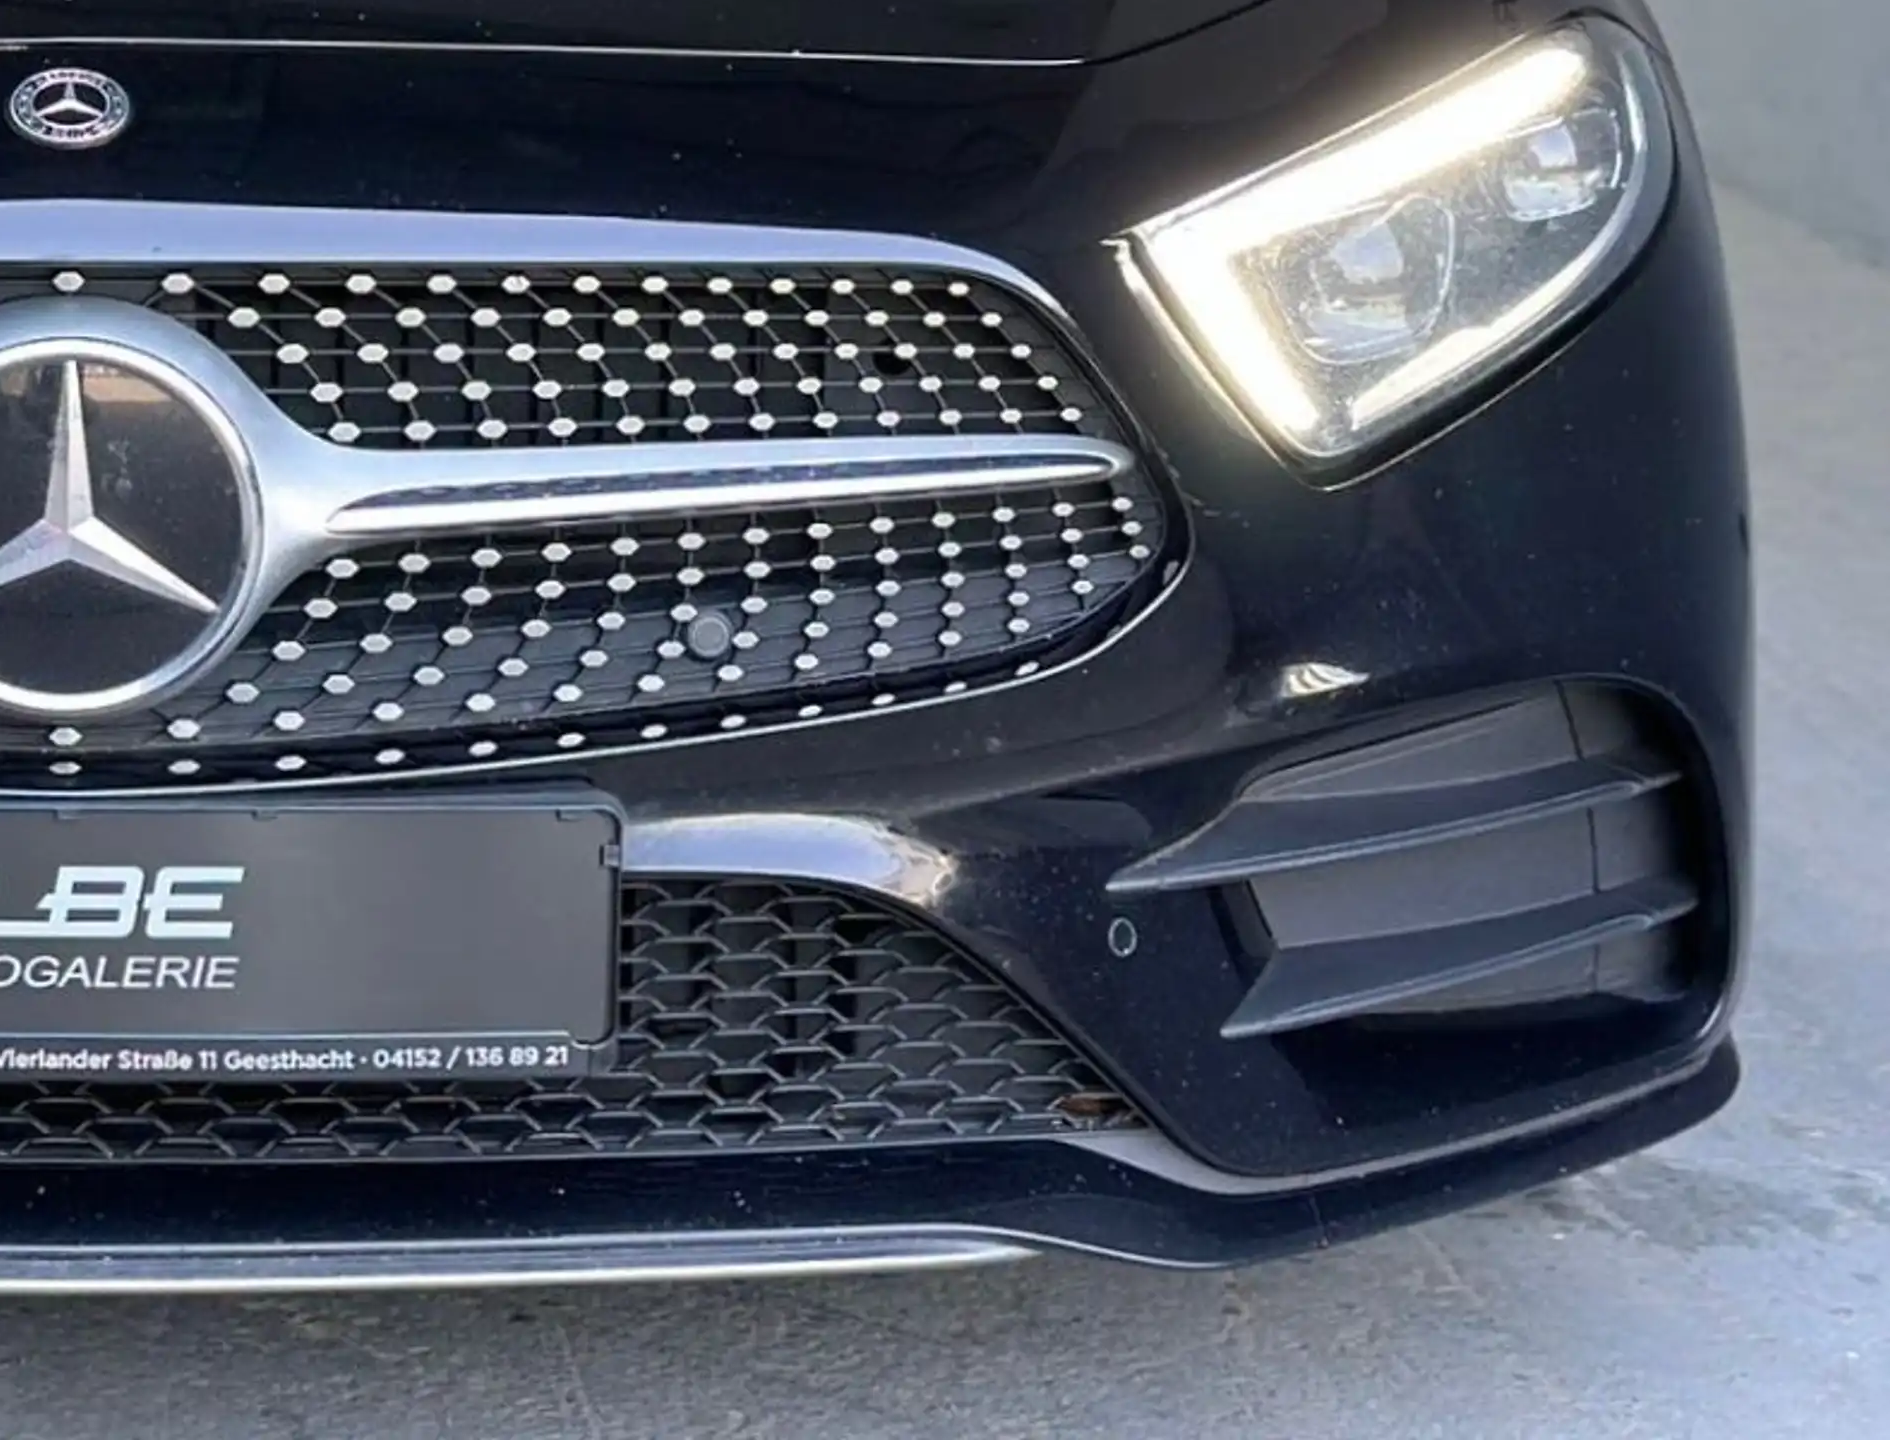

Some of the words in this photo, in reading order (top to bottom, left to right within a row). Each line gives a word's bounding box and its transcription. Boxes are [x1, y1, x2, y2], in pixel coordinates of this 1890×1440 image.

[118, 1048, 194, 1071] Straße
[198, 1049, 218, 1071] 11
[223, 1048, 355, 1071] Geesthacht
[372, 1047, 442, 1070] 04152
[465, 1046, 505, 1067] 136
[509, 1045, 540, 1067] 89
[543, 1044, 569, 1066] 21
